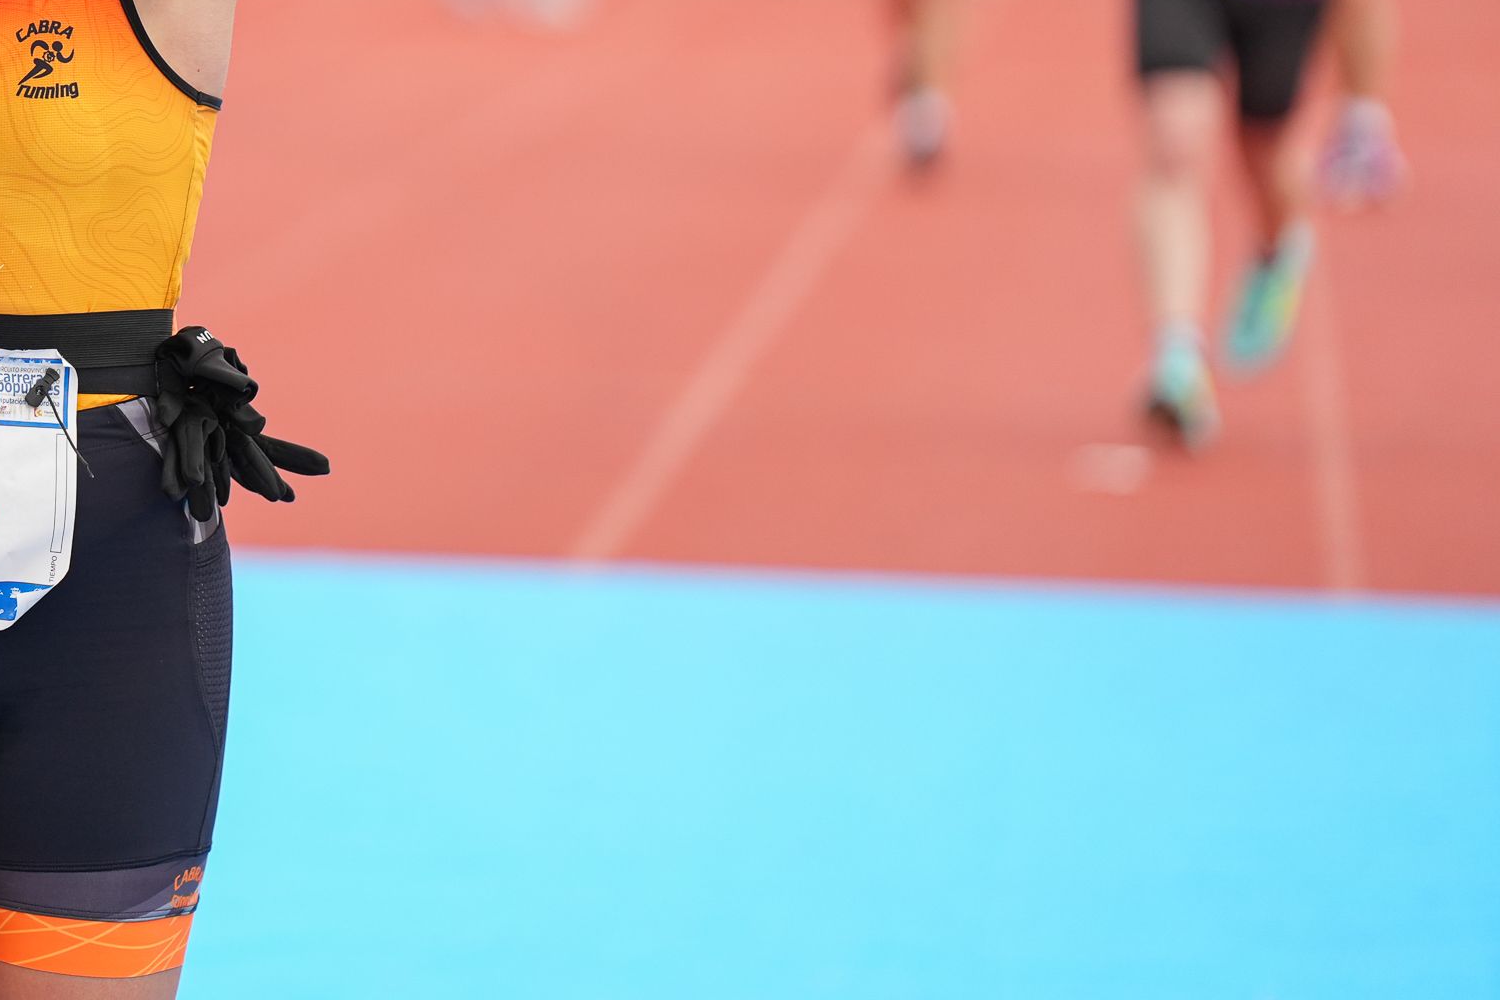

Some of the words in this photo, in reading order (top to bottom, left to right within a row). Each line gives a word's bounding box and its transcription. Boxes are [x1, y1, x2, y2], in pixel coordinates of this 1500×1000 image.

[15, 19, 74, 43] CABRA
[16, 81, 80, 99] running
[49, 555, 57, 583] TIEMPO
